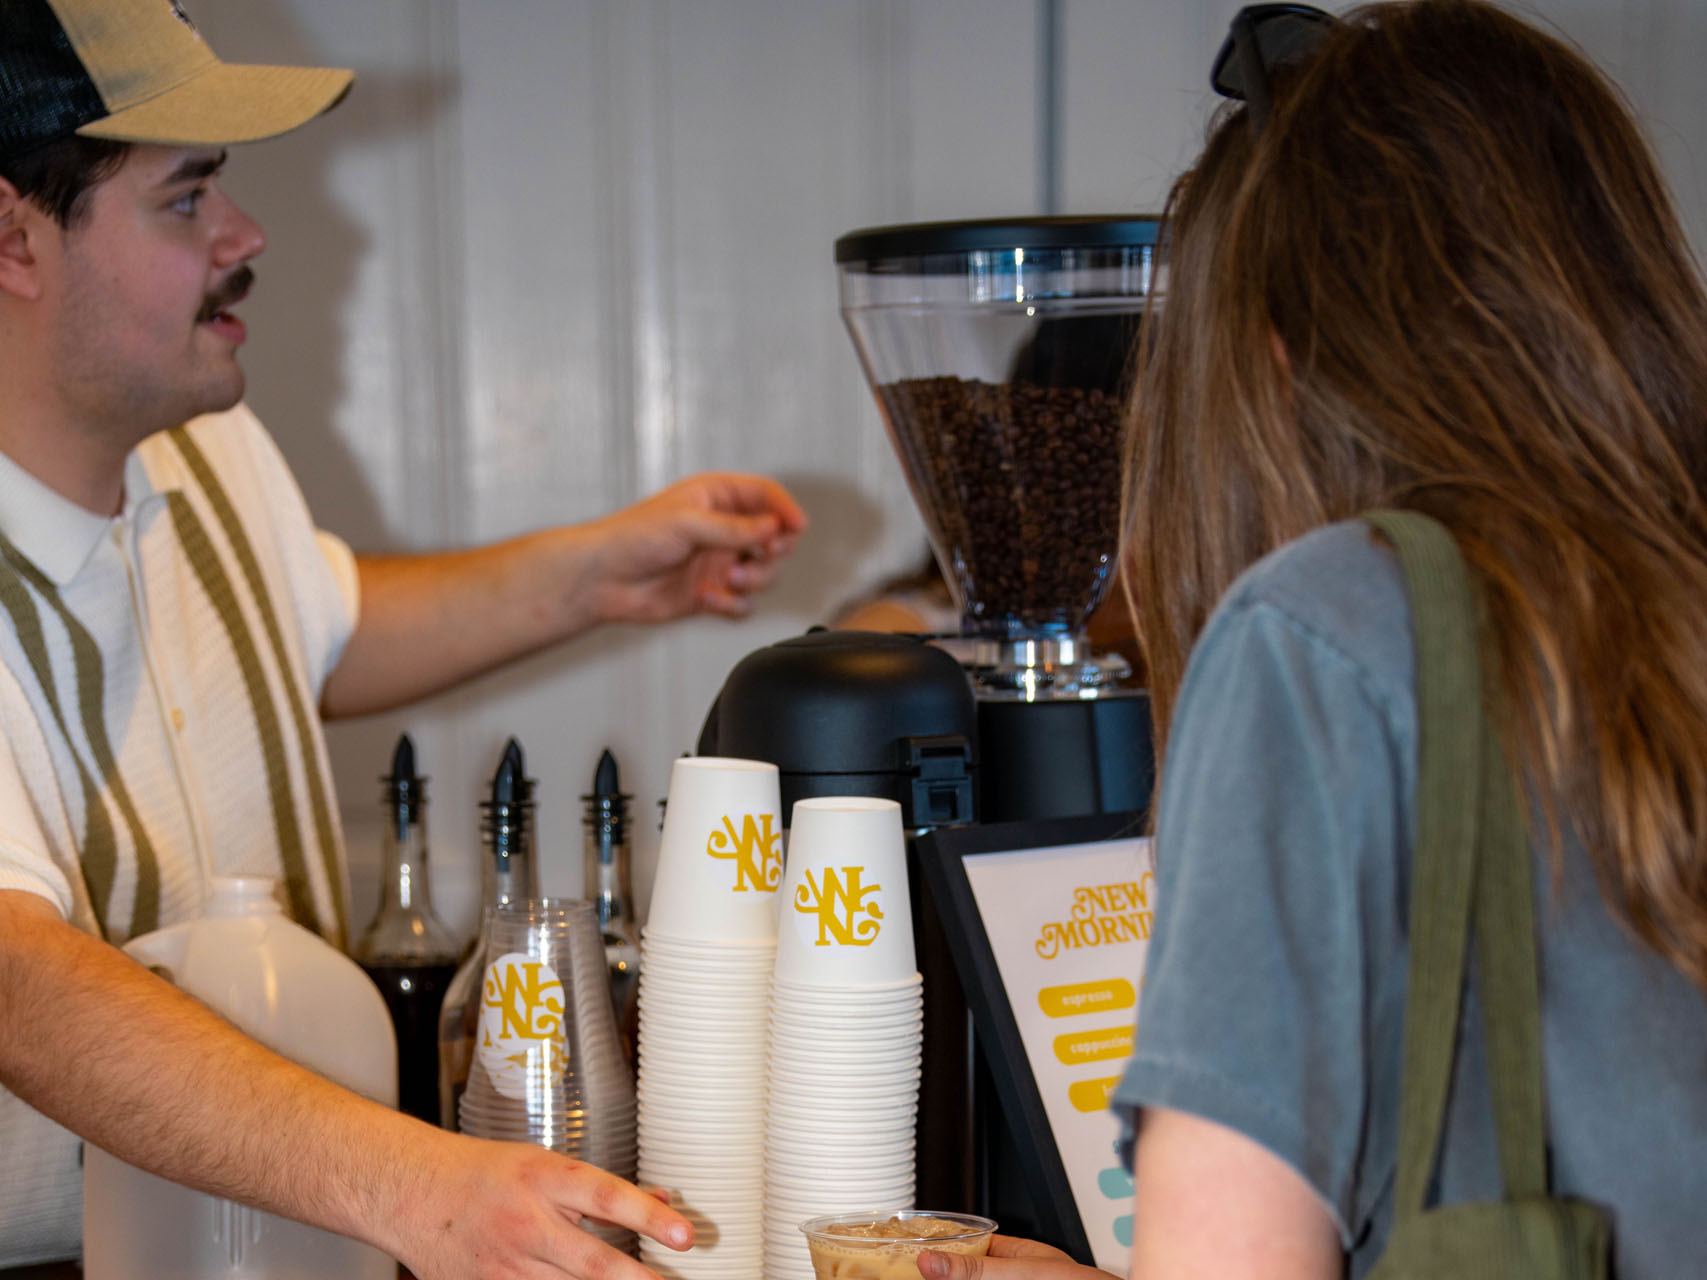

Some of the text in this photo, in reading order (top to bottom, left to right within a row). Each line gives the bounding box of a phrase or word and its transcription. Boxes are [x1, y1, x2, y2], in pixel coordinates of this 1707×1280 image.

[1071, 871, 1154, 922] NEW
[1035, 911, 1153, 961] MORNI
[1062, 990, 1114, 1008] espresso
